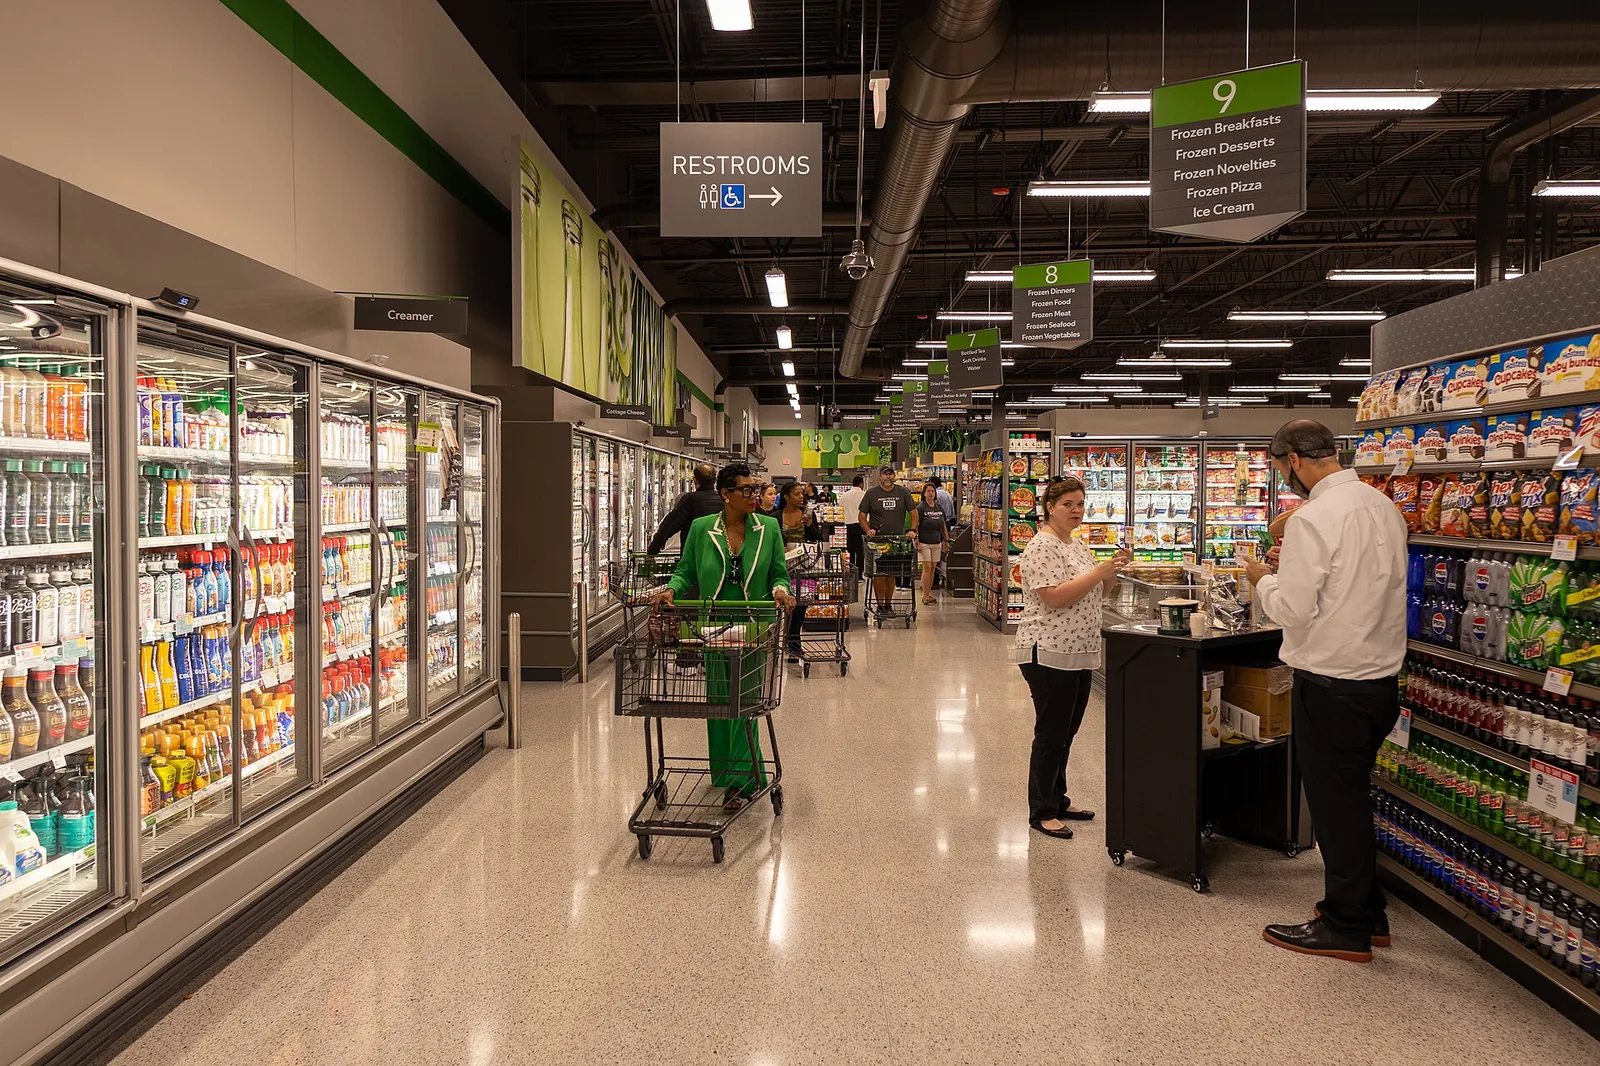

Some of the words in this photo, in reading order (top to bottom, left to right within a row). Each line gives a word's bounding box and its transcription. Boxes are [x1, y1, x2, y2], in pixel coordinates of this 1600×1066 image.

[1213, 80, 1237, 113] 9
[1171, 127, 1212, 141] Frozen
[1214, 114, 1281, 134] Breakfasts
[1176, 146, 1217, 160] Frozen
[1219, 136, 1275, 154] Desserts
[673, 155, 810, 175] RESTROOMS
[1174, 167, 1214, 181] Frozen
[1217, 157, 1276, 174] Novelties
[1187, 185, 1227, 199] Frozen
[1230, 180, 1262, 193] Pizza
[1193, 207, 1210, 218] Ice
[1213, 202, 1255, 215] Cream
[1045, 265, 1058, 284] 8
[1027, 289, 1050, 297] Frozen
[1050, 287, 1076, 295] Dinners
[1054, 298, 1071, 306] Food
[387, 309, 434, 321] Creamer
[1048, 320, 1076, 329] Seafood
[967, 333, 977, 347] 7
[1021, 333, 1043, 341] Frozen
[1044, 331, 1080, 341] Vegetables
[1546, 360, 1568, 375] baby
[1494, 368, 1537, 386] Cupcakes
[916, 381, 923, 391] 5
[1447, 377, 1484, 393] Cupcakes
[606, 408, 626, 416] Cottage
[1533, 428, 1549, 439] Ding
[1360, 443, 1382, 453] Twinkies
[1387, 440, 1413, 450] Twinkies
[1419, 438, 1445, 449] Twinkies
[1451, 435, 1482, 447] Twinkies
[1459, 481, 1480, 494] hex
[1490, 478, 1518, 494] hex
[1521, 476, 1550, 496] Chx
